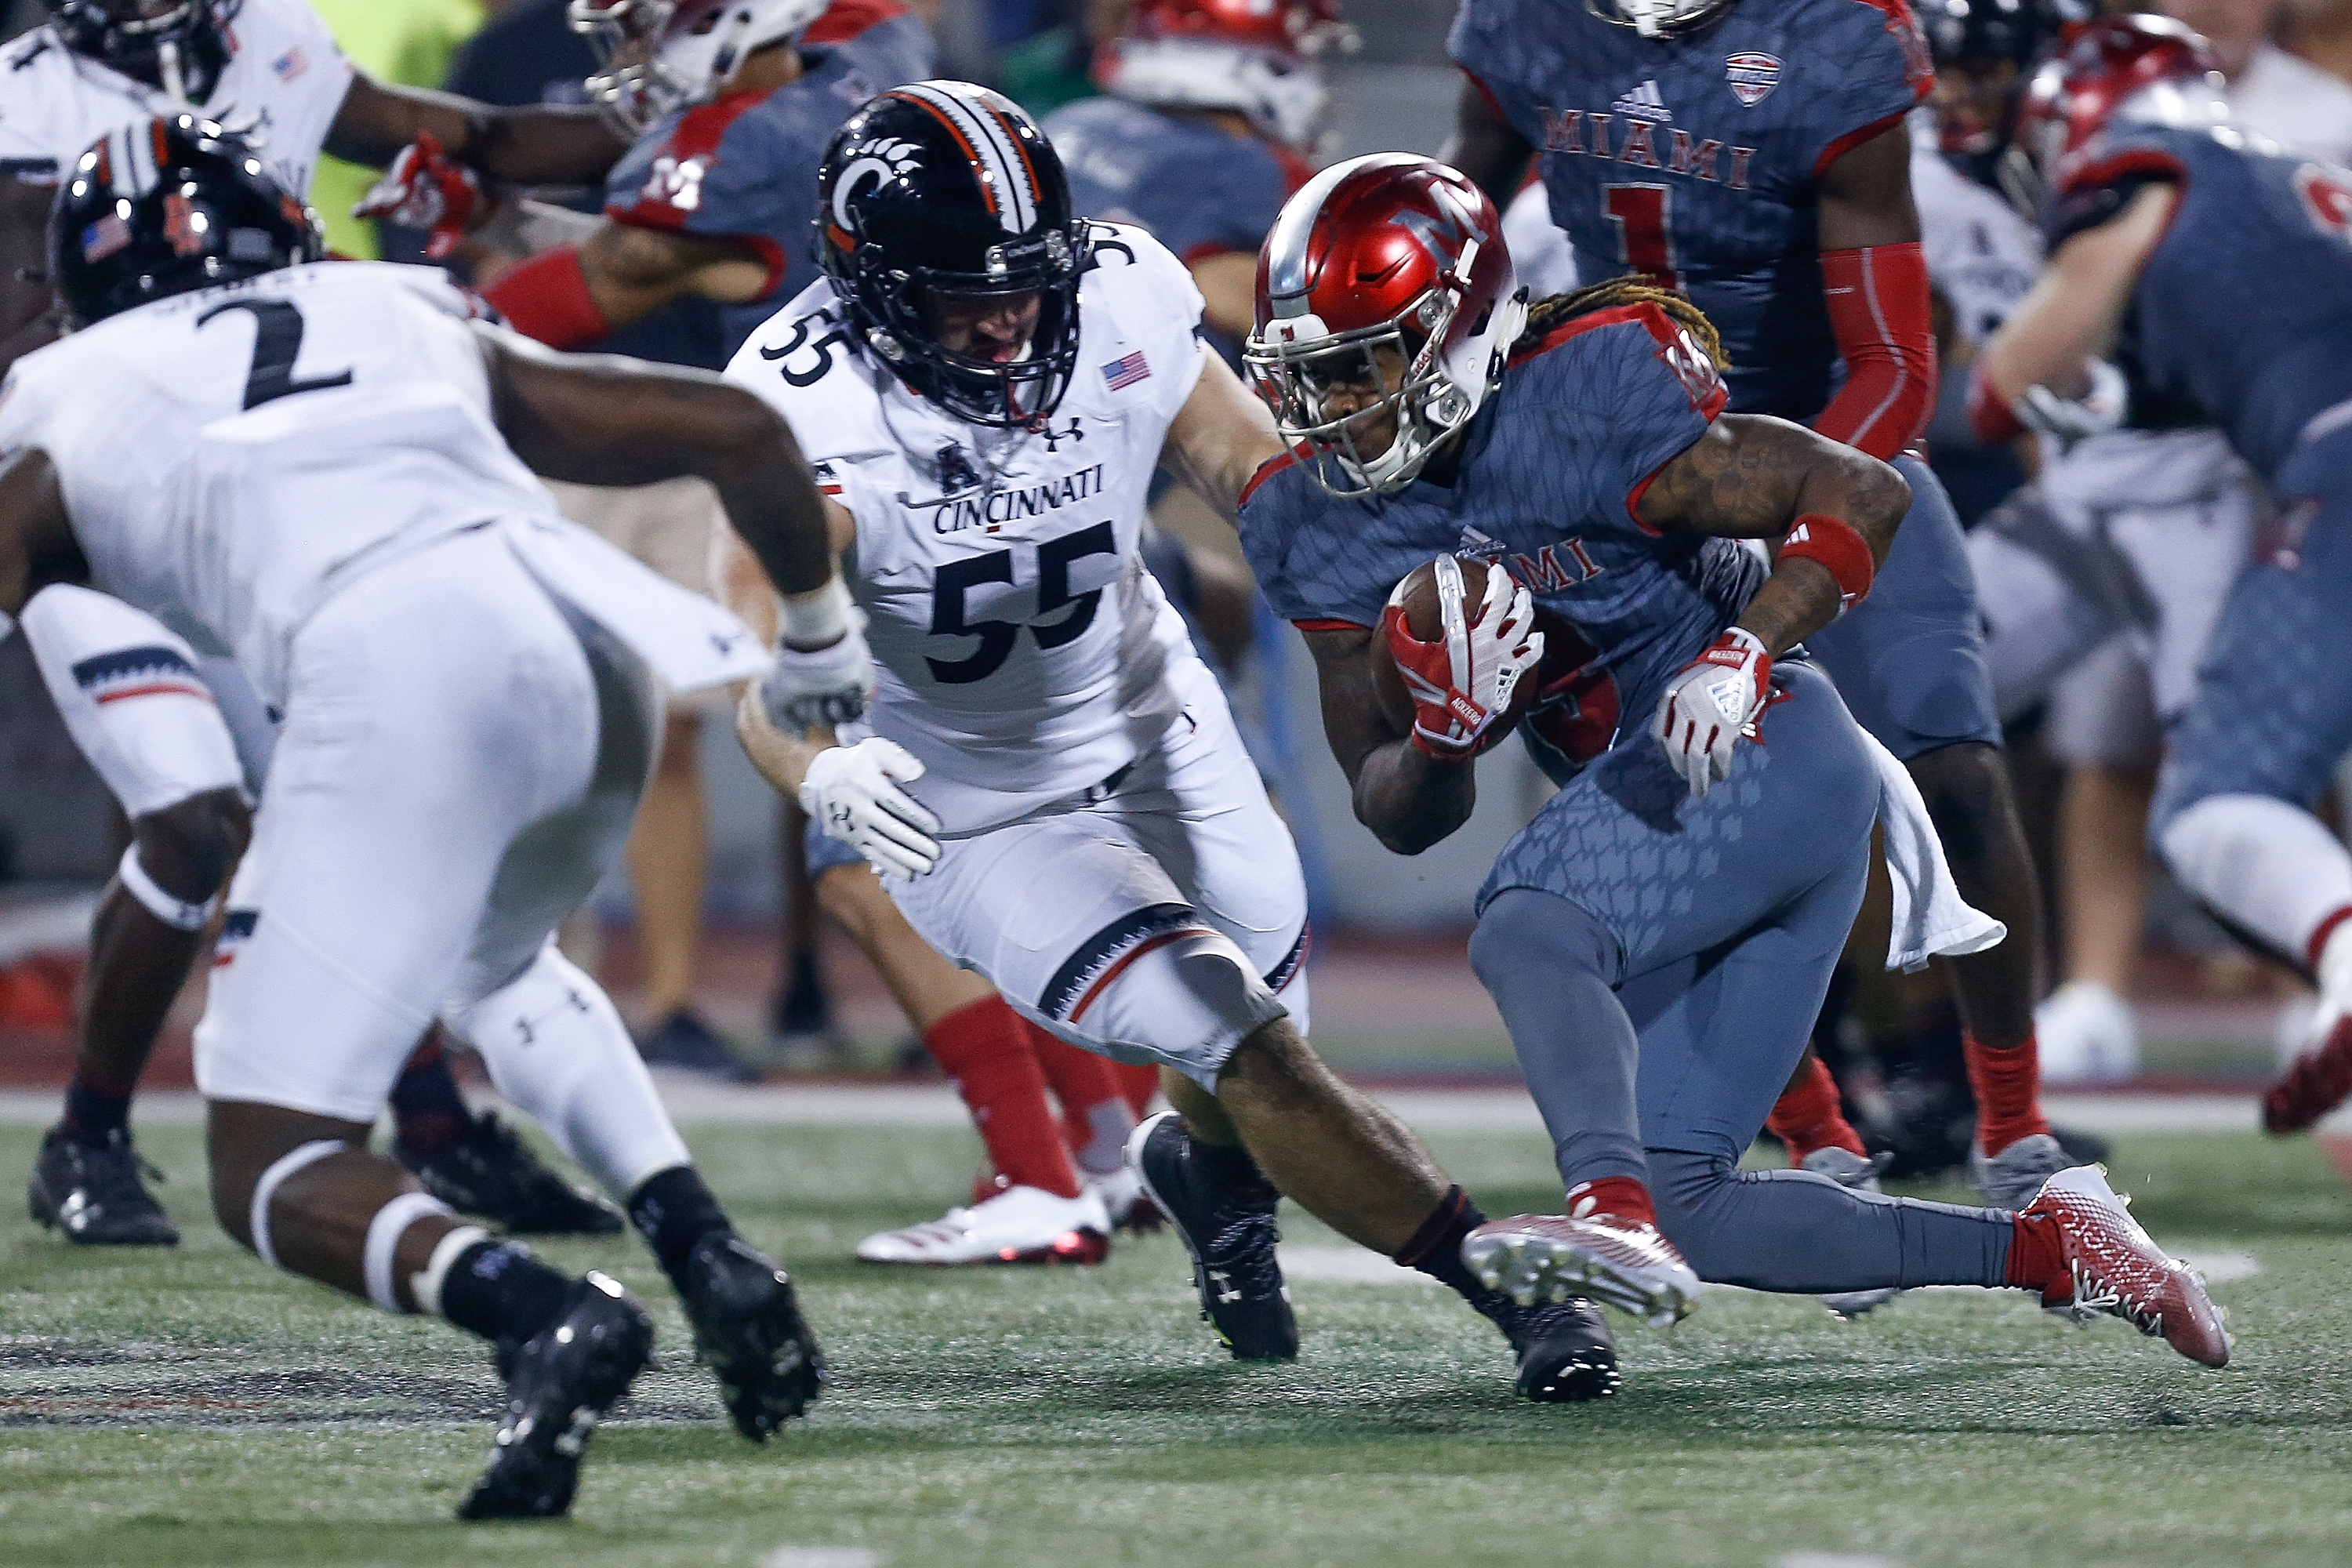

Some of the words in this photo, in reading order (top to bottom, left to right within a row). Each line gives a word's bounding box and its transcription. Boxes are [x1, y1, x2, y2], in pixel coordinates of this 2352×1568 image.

[1537, 106, 1758, 191] MIAMI
[1600, 181, 1687, 290] 1
[196, 297, 353, 412] 2
[760, 308, 863, 388] 55
[934, 463, 1105, 535] CINCINNATI
[924, 520, 1118, 684] 55
